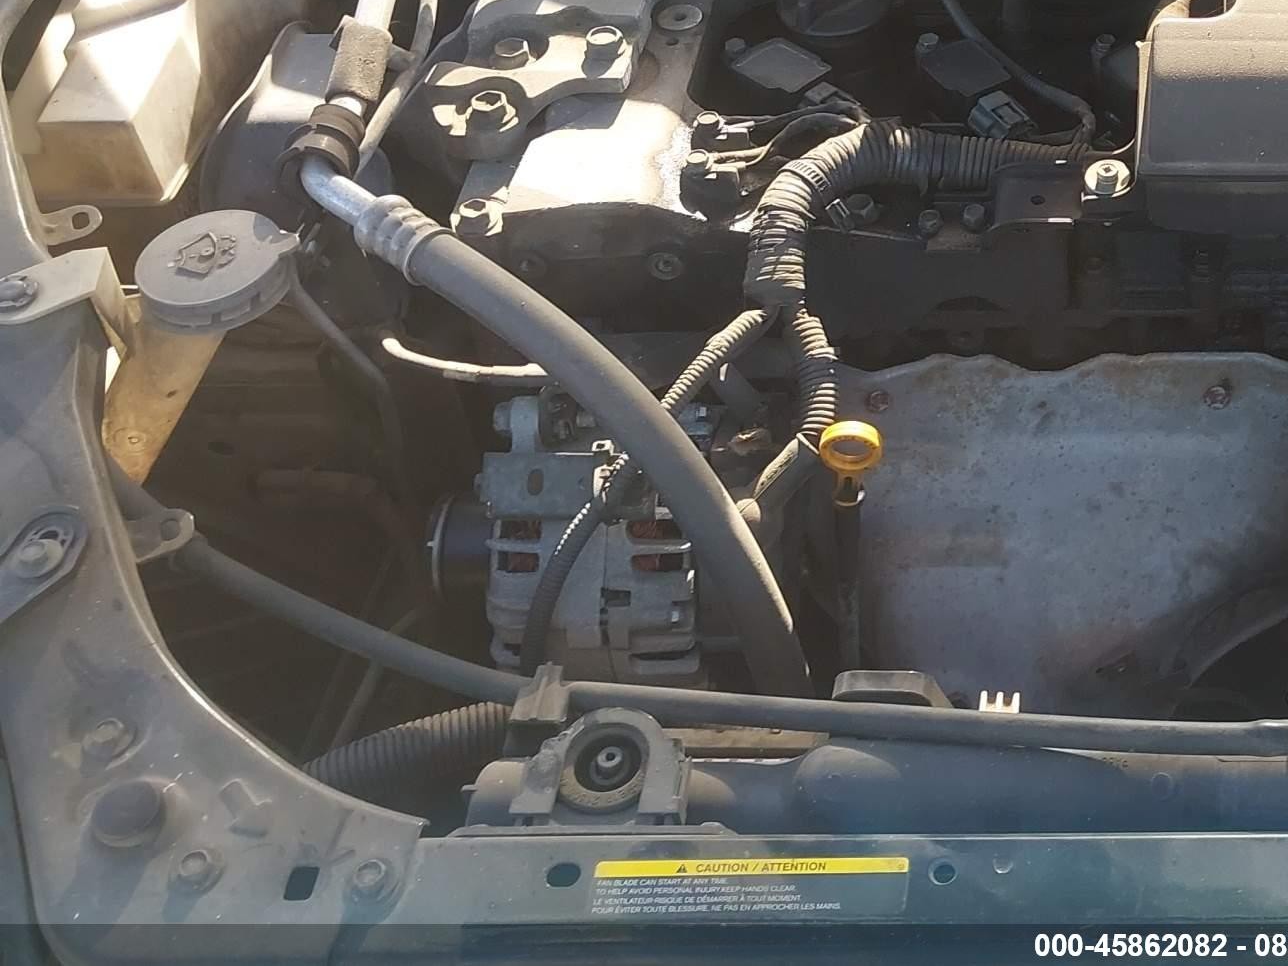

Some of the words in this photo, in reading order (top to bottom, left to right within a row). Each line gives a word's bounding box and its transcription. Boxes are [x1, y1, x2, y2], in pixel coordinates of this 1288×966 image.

[696, 863, 749, 873] CAUTION
[761, 861, 827, 872] ATTENTION
[604, 897, 653, 905] VENTILATEUR
[696, 893, 739, 903] DÉMARRER
[614, 905, 641, 914] ÉVITER
[642, 906, 668, 914] TOUTE
